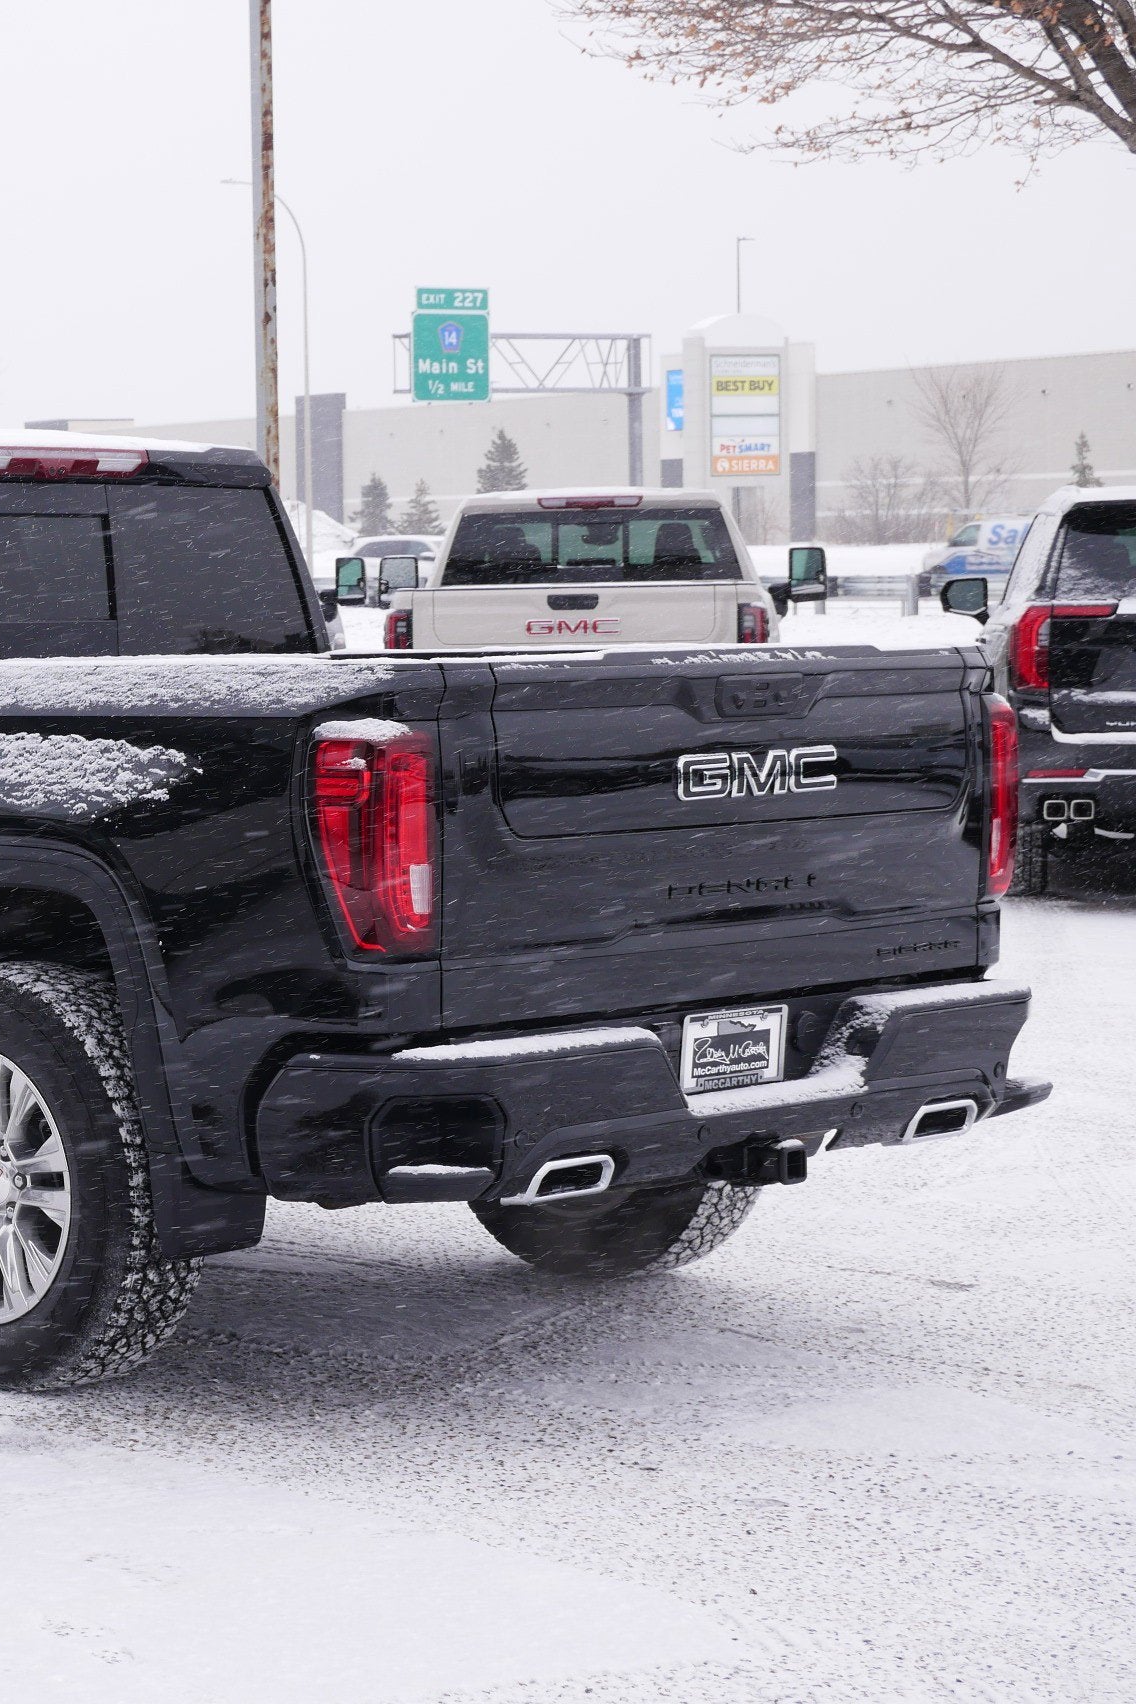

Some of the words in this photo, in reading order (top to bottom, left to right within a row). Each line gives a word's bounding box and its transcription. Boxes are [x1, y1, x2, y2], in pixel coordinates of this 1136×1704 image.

[421, 294, 446, 305] EXIT
[453, 292, 484, 307] 227
[444, 331, 458, 346] 14
[418, 358, 459, 374] Main
[466, 358, 485, 374] St
[450, 382, 475, 393] MILE
[716, 380, 746, 392] BEST
[749, 379, 774, 391] BUY
[731, 459, 775, 472] SIERRA
[526, 619, 620, 634] GMC
[676, 744, 837, 801] GMC
[708, 1009, 764, 1020] MINNESOTA
[693, 1060, 768, 1077] McCarthyauto.com
[704, 1075, 758, 1091] MCCARTHY
